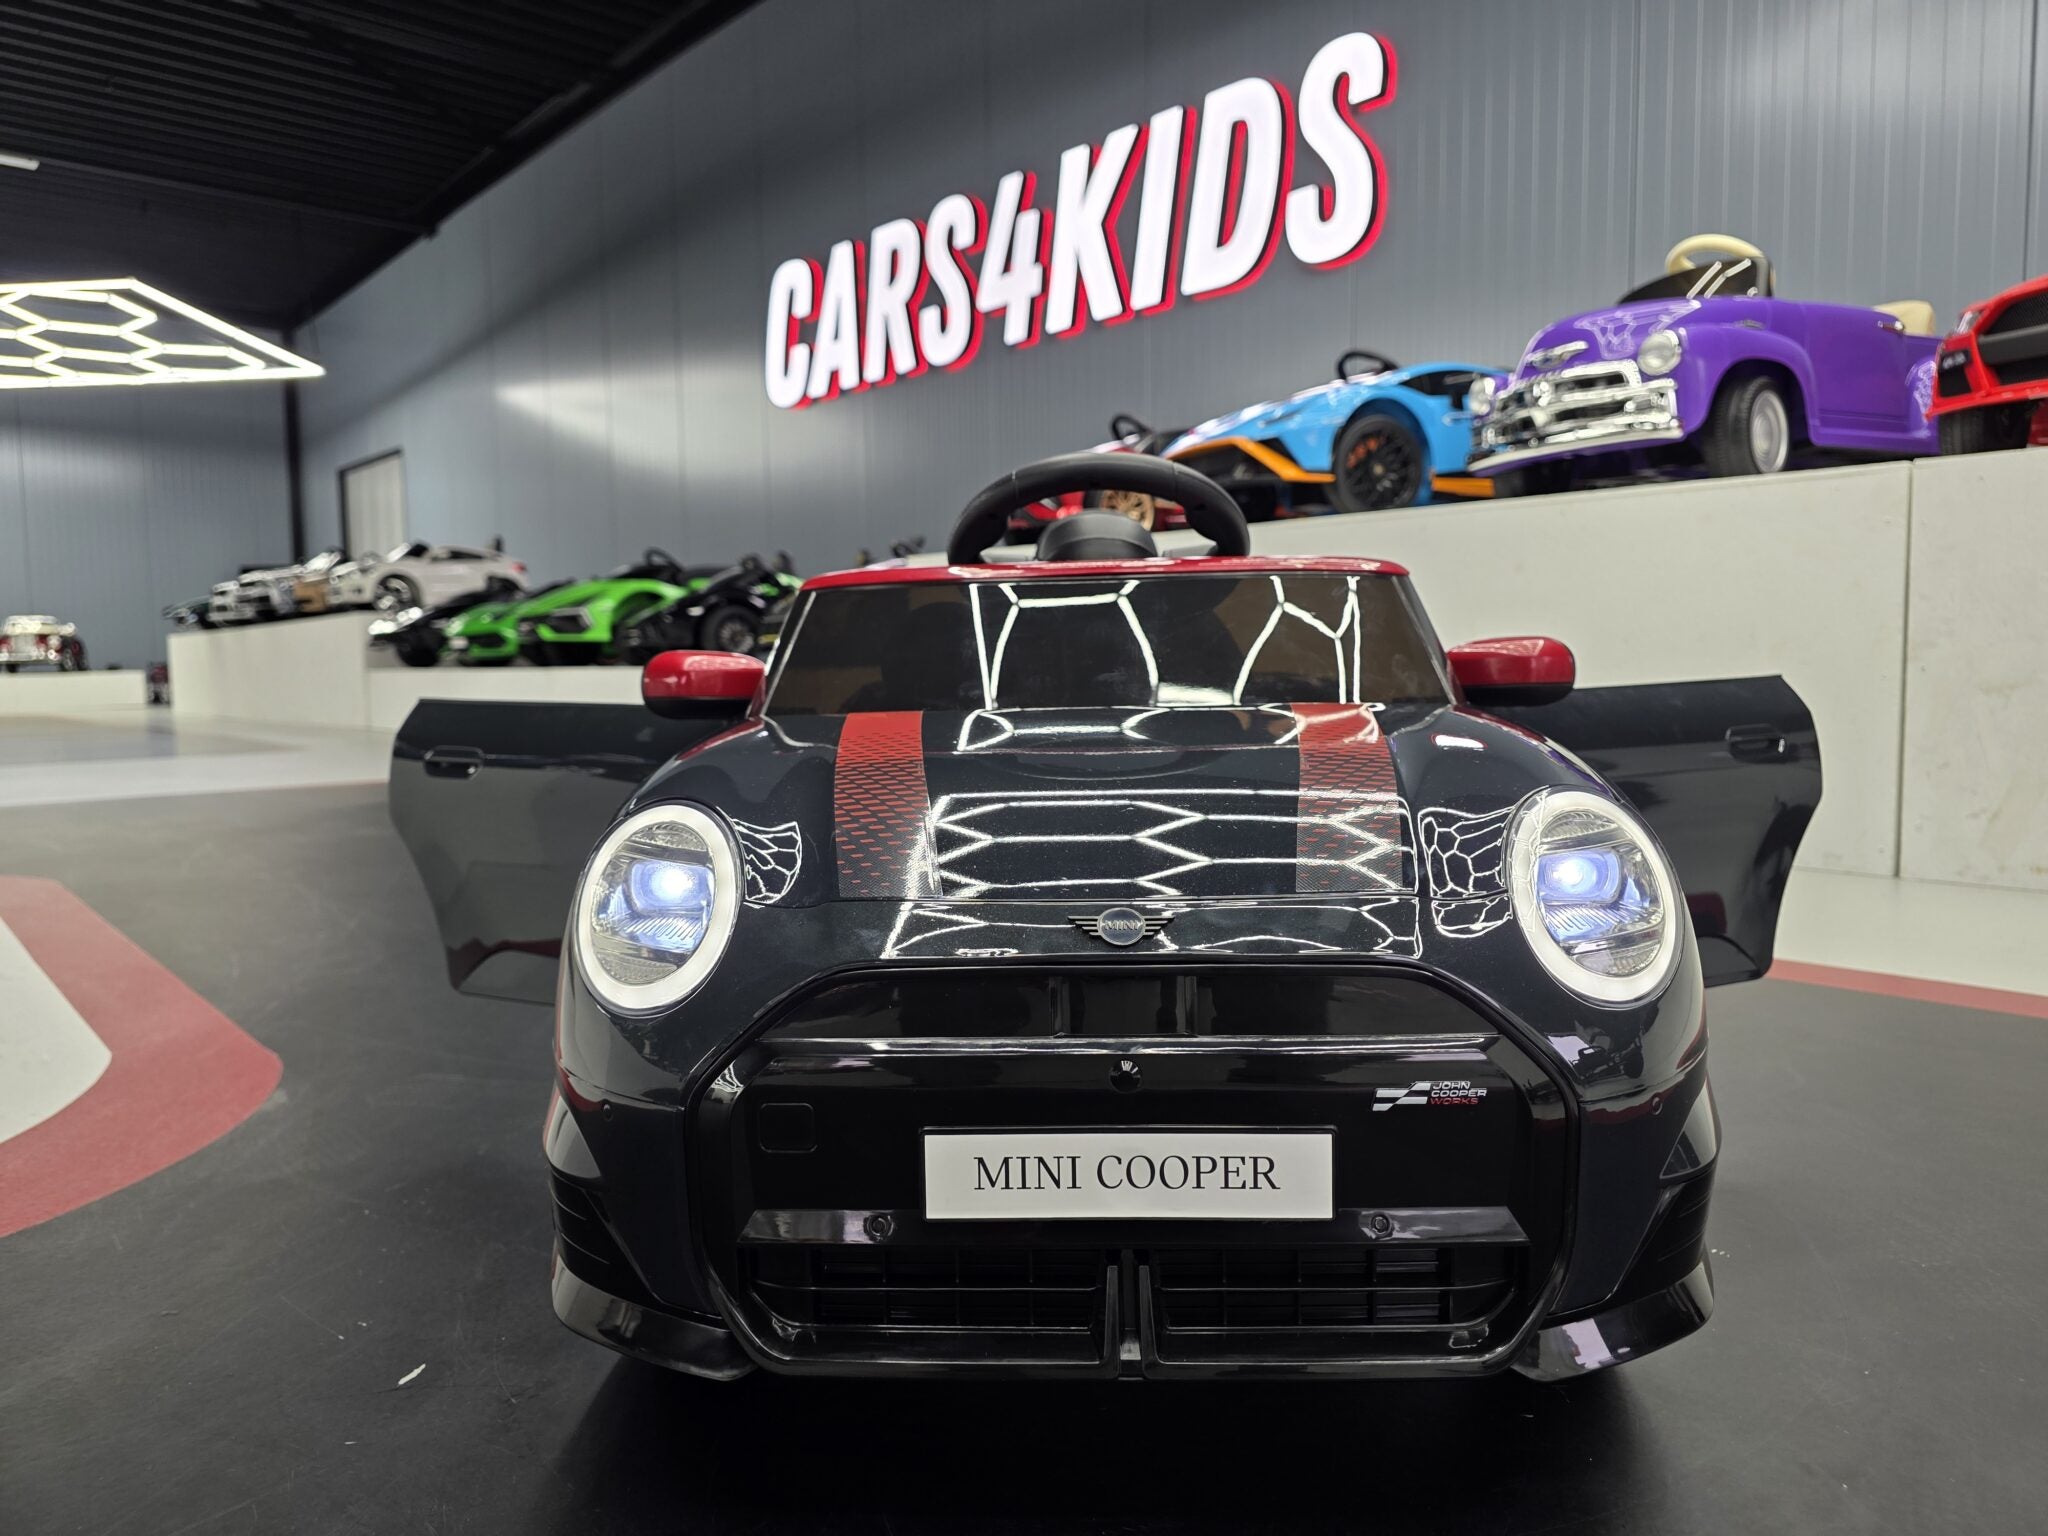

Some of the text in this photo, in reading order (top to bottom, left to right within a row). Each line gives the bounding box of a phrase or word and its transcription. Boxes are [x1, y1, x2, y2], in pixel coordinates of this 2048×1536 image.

[765, 32, 1395, 408] CARS4KIDS
[1104, 919, 1140, 931] MINI
[1432, 1081, 1471, 1090] JOHN
[1431, 1089, 1487, 1097] COOPER
[1430, 1097, 1479, 1105] WORKS
[973, 1155, 1281, 1191] MINI COOPER
